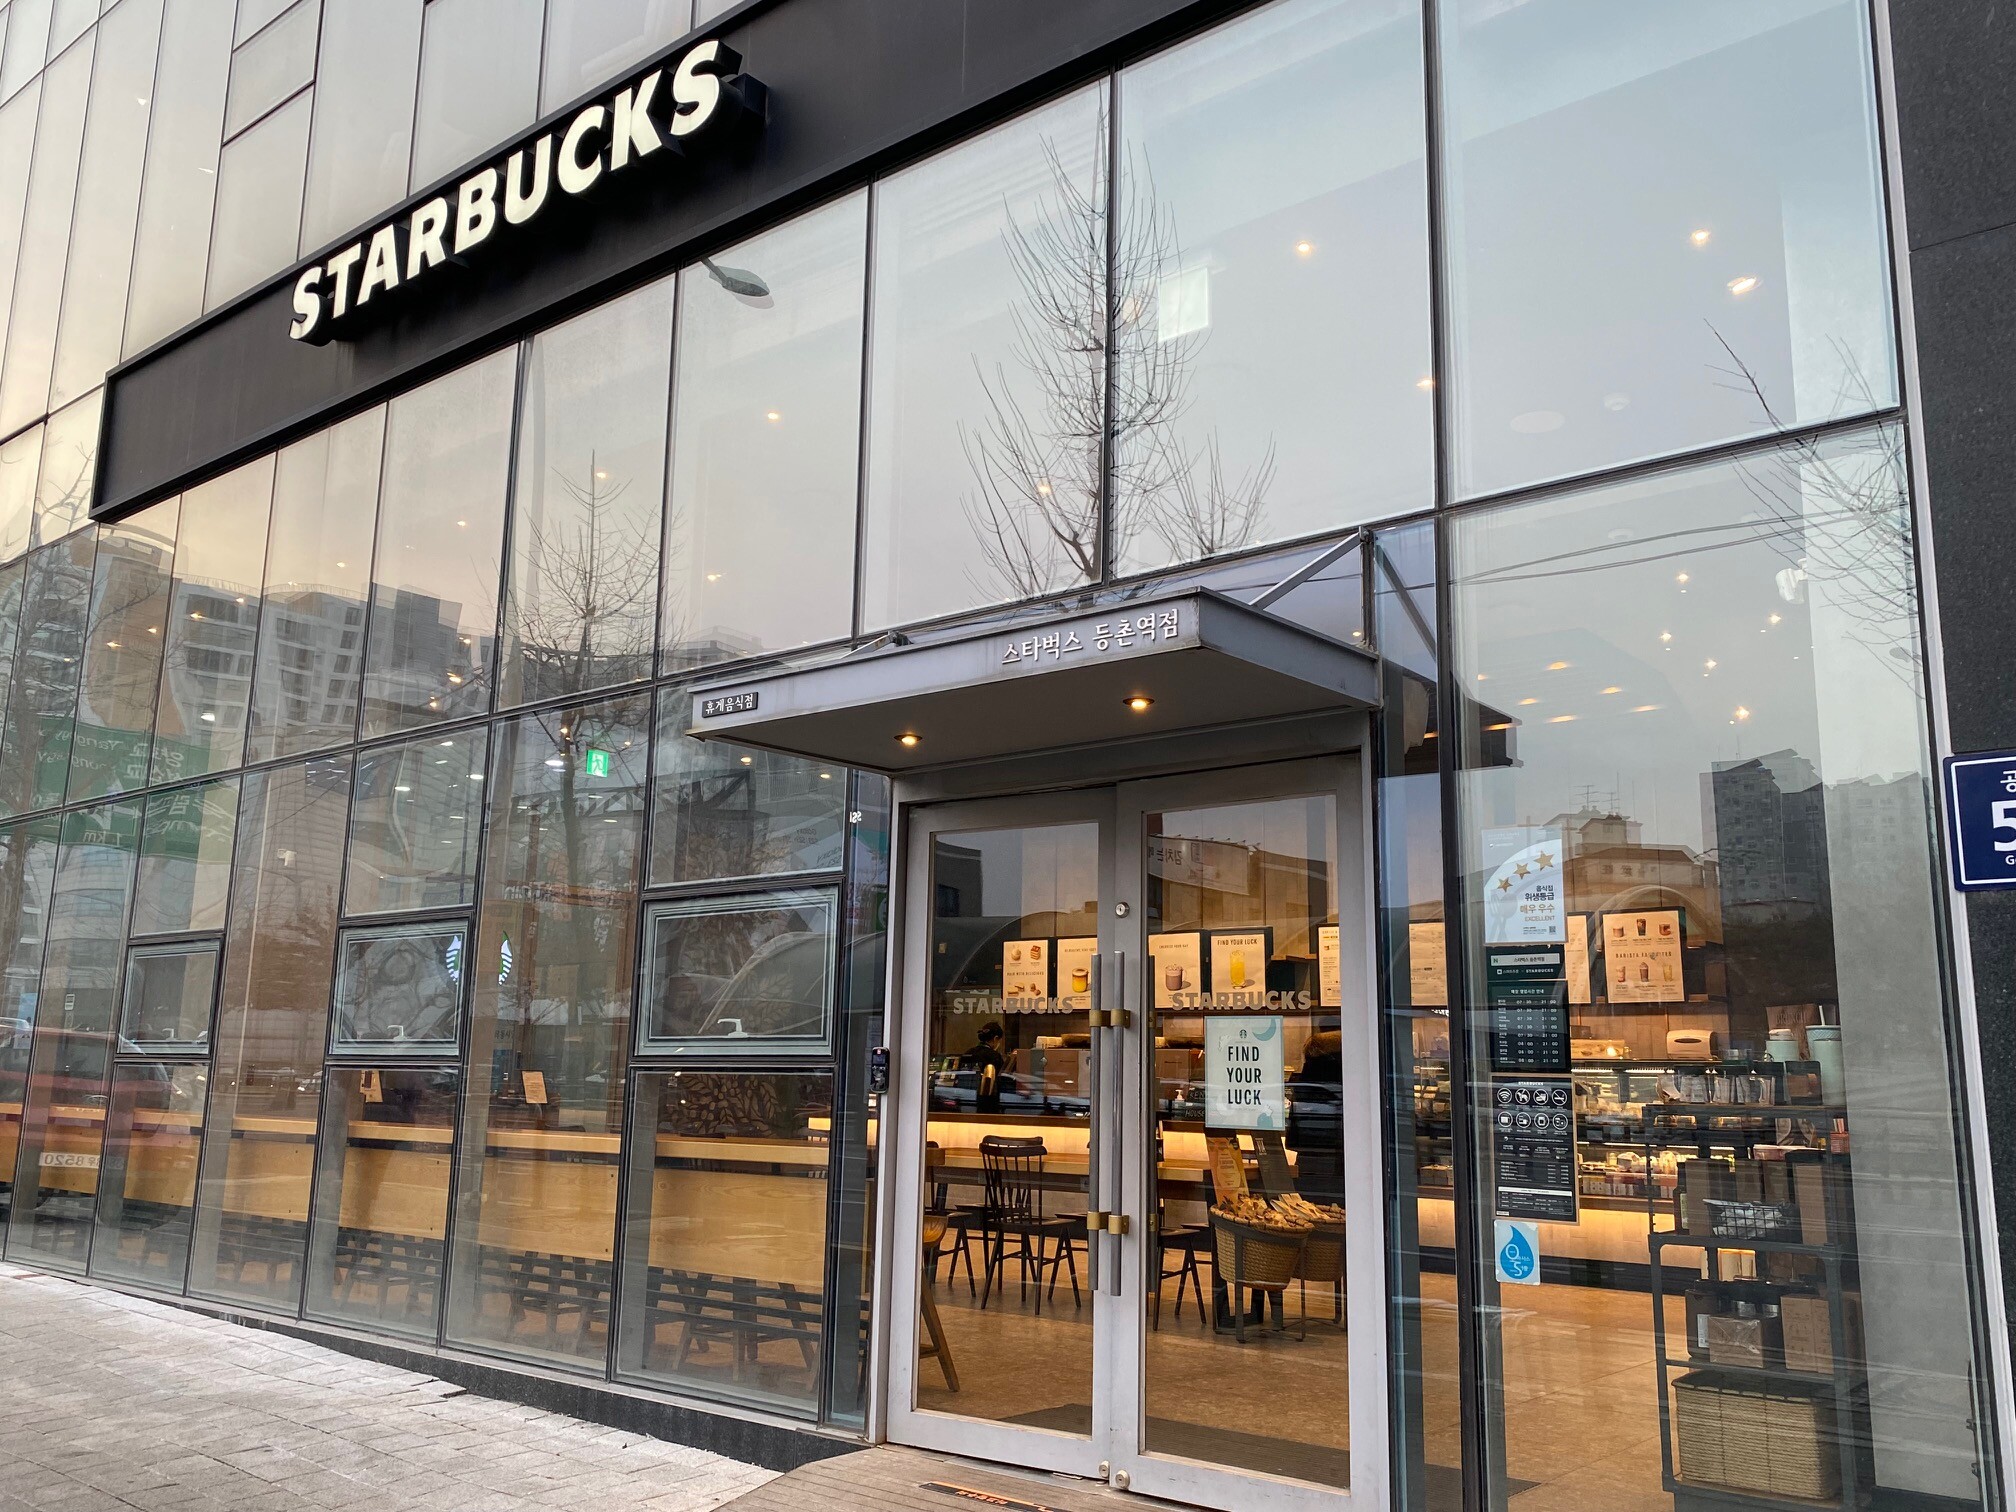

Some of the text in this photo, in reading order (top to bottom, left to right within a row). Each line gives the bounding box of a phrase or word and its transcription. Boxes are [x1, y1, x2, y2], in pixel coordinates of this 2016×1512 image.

[289, 39, 720, 340] STARBUCKS
[1001, 608, 1179, 664] 스타벅스 등촌역점
[705, 693, 754, 715] 휴게음식점
[1525, 892, 1555, 901] 위생등급
[1538, 903, 1555, 913] 우수
[953, 996, 1074, 1014] STARBUCKS
[1172, 990, 1312, 1010] STARBUCKS
[1228, 1046, 1260, 1062] FIND
[1226, 1067, 1262, 1084] YOUR
[1227, 1089, 1262, 1105] LUCK
